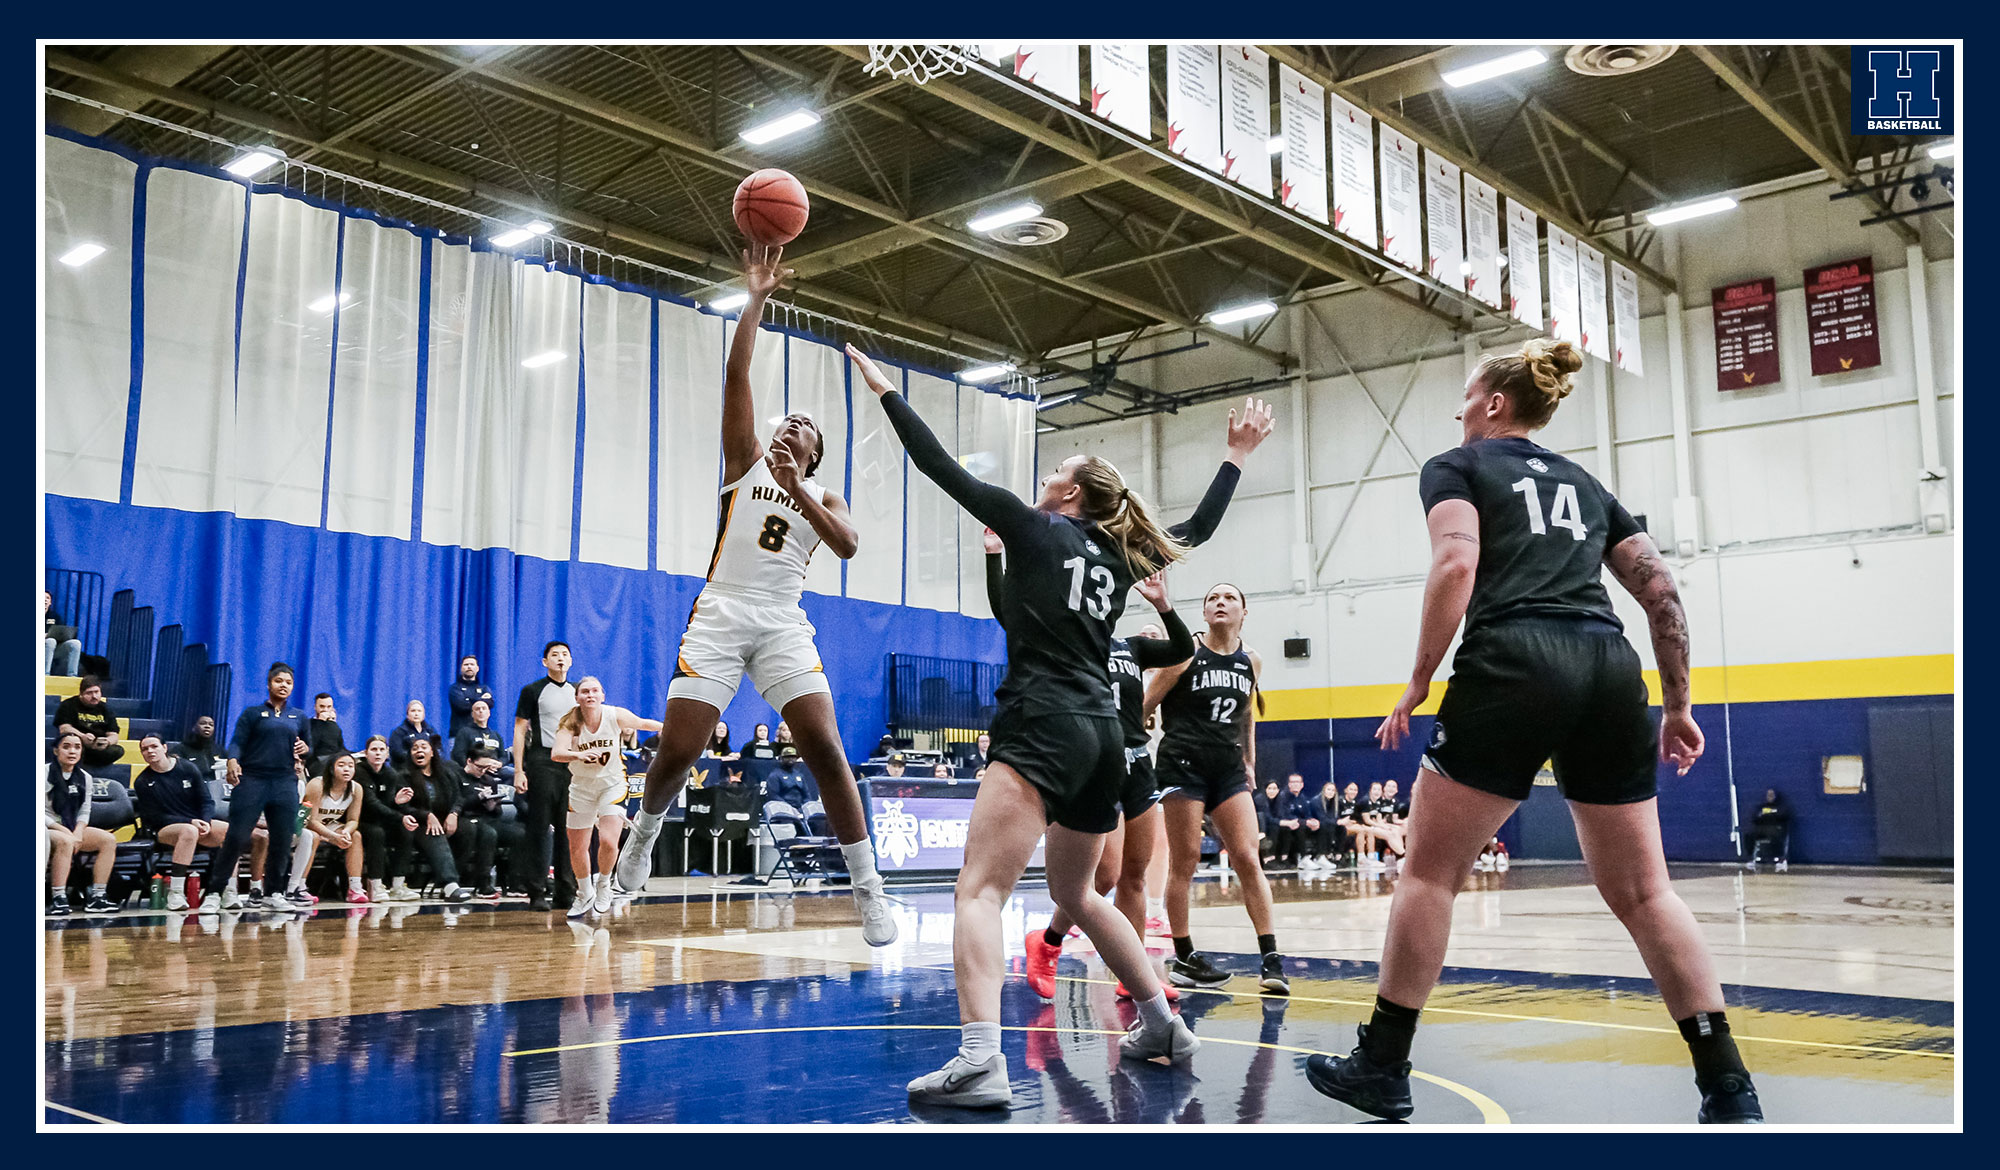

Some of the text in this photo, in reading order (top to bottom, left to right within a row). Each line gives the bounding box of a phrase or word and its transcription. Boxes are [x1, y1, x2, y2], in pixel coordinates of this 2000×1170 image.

[751, 486, 804, 515] HUMB
[1511, 477, 1589, 541] 14
[758, 514, 791, 553] 8
[1063, 556, 1116, 621] 13
[1107, 657, 1142, 682] BTON
[1191, 669, 1252, 697] LAMBTON
[1210, 696, 1238, 724] 12
